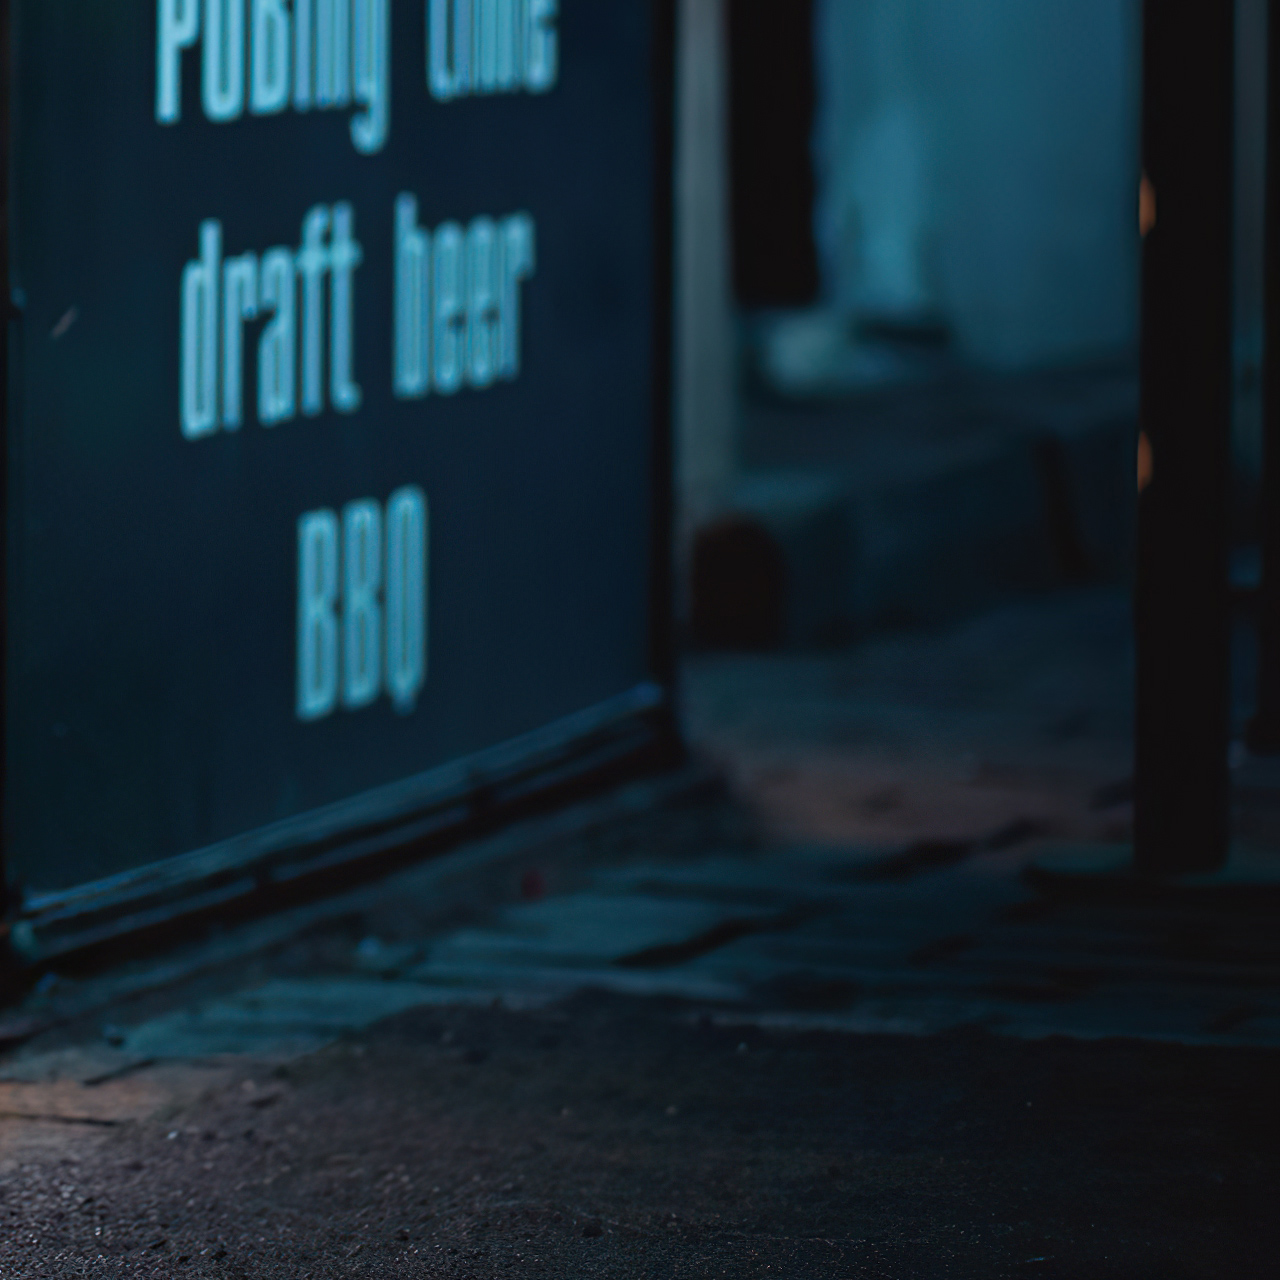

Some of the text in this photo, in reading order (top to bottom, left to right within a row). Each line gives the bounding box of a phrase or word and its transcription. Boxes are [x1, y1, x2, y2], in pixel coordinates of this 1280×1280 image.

[180, 193, 534, 439] draft beer
[297, 486, 427, 718] BBQ
